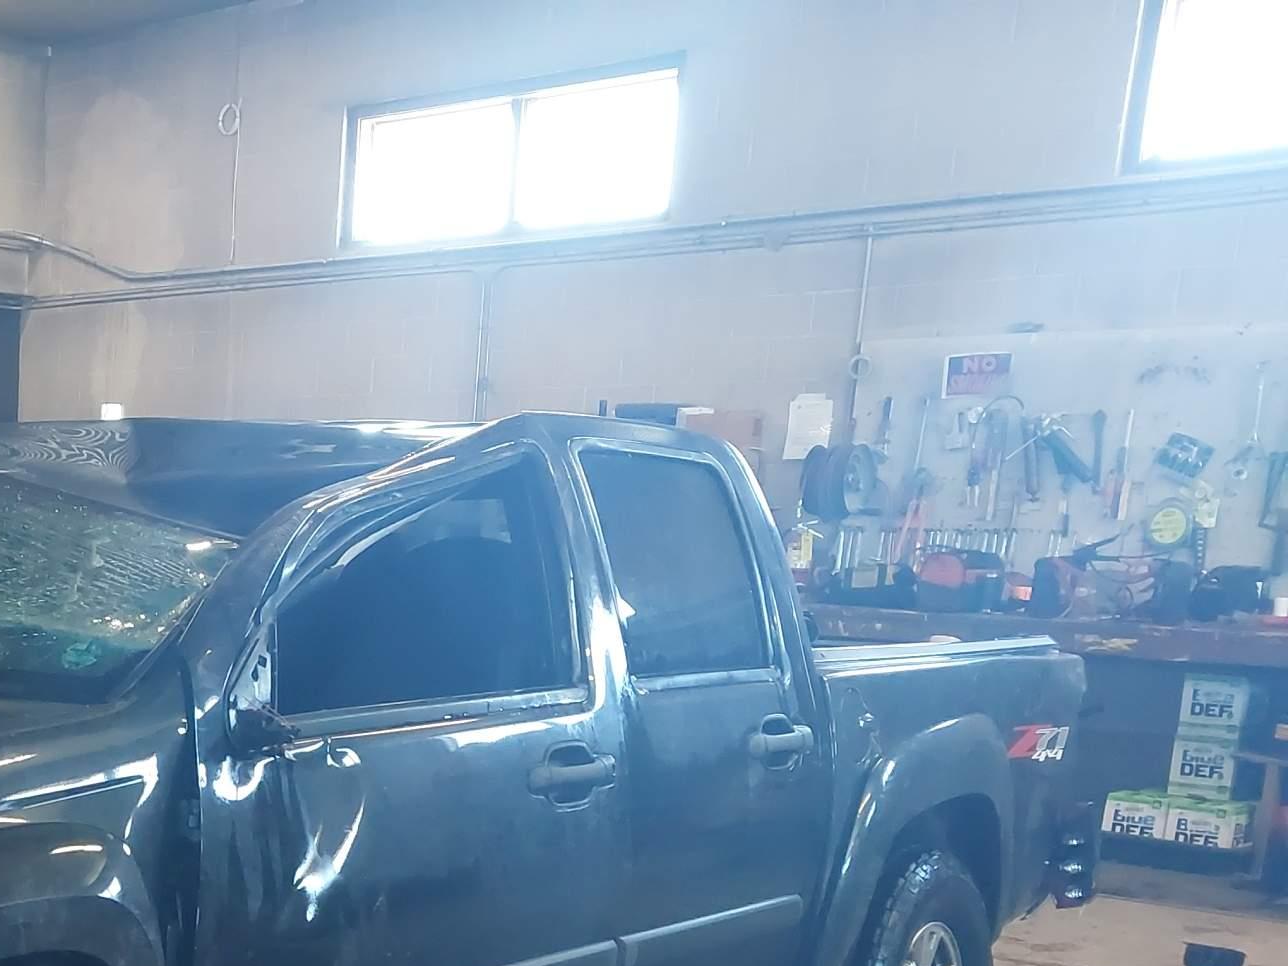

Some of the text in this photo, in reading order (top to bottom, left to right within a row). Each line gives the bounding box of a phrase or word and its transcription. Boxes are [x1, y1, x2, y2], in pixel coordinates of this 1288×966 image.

[962, 357, 996, 374] NO
[1191, 702, 1234, 718] DEF
[1007, 724, 1069, 758] Z71
[1180, 762, 1224, 779] DEF
